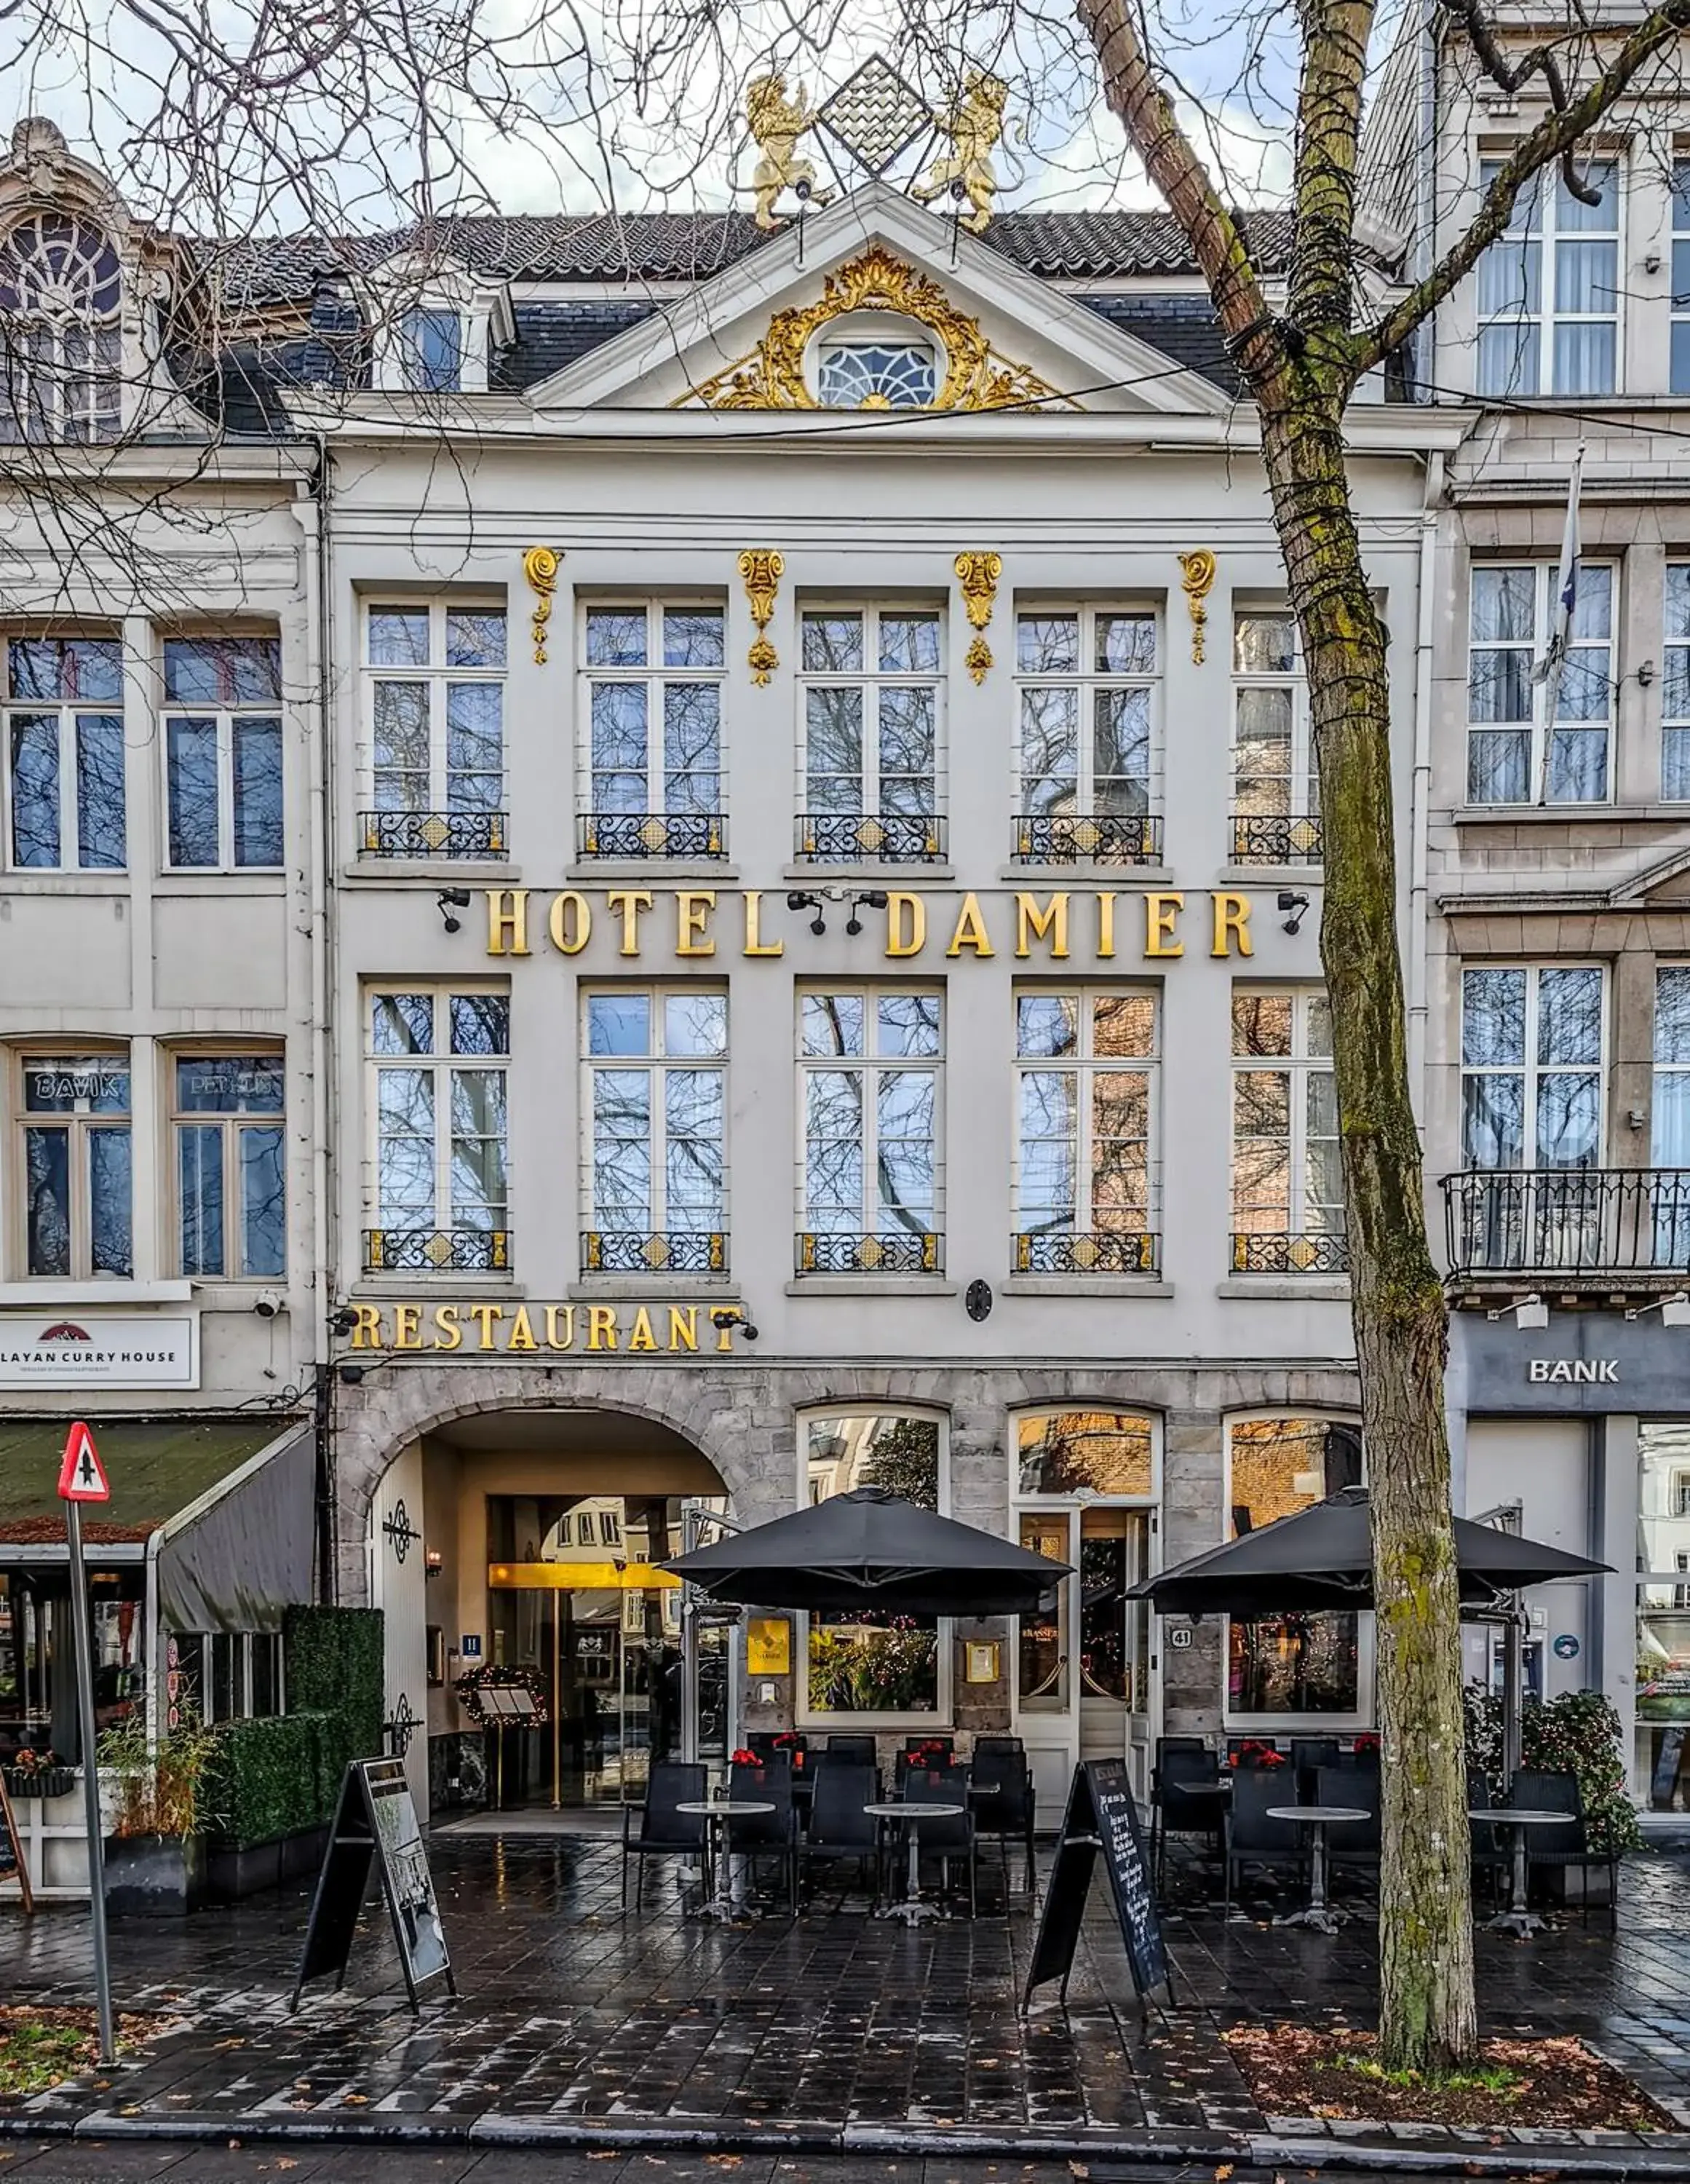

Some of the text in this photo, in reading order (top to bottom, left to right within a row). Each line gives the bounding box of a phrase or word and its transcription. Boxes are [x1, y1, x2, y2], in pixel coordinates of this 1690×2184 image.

[485, 890, 1254, 957] HOTEL DAMIER
[35, 1073, 119, 1098] BAVIK
[350, 1304, 742, 1350] RESTAURANT
[62, 1352, 115, 1362] CURRY
[122, 1352, 175, 1362] HOUSE
[1530, 1359, 1619, 1382] BANK
[1174, 1631, 1189, 1644] 41
